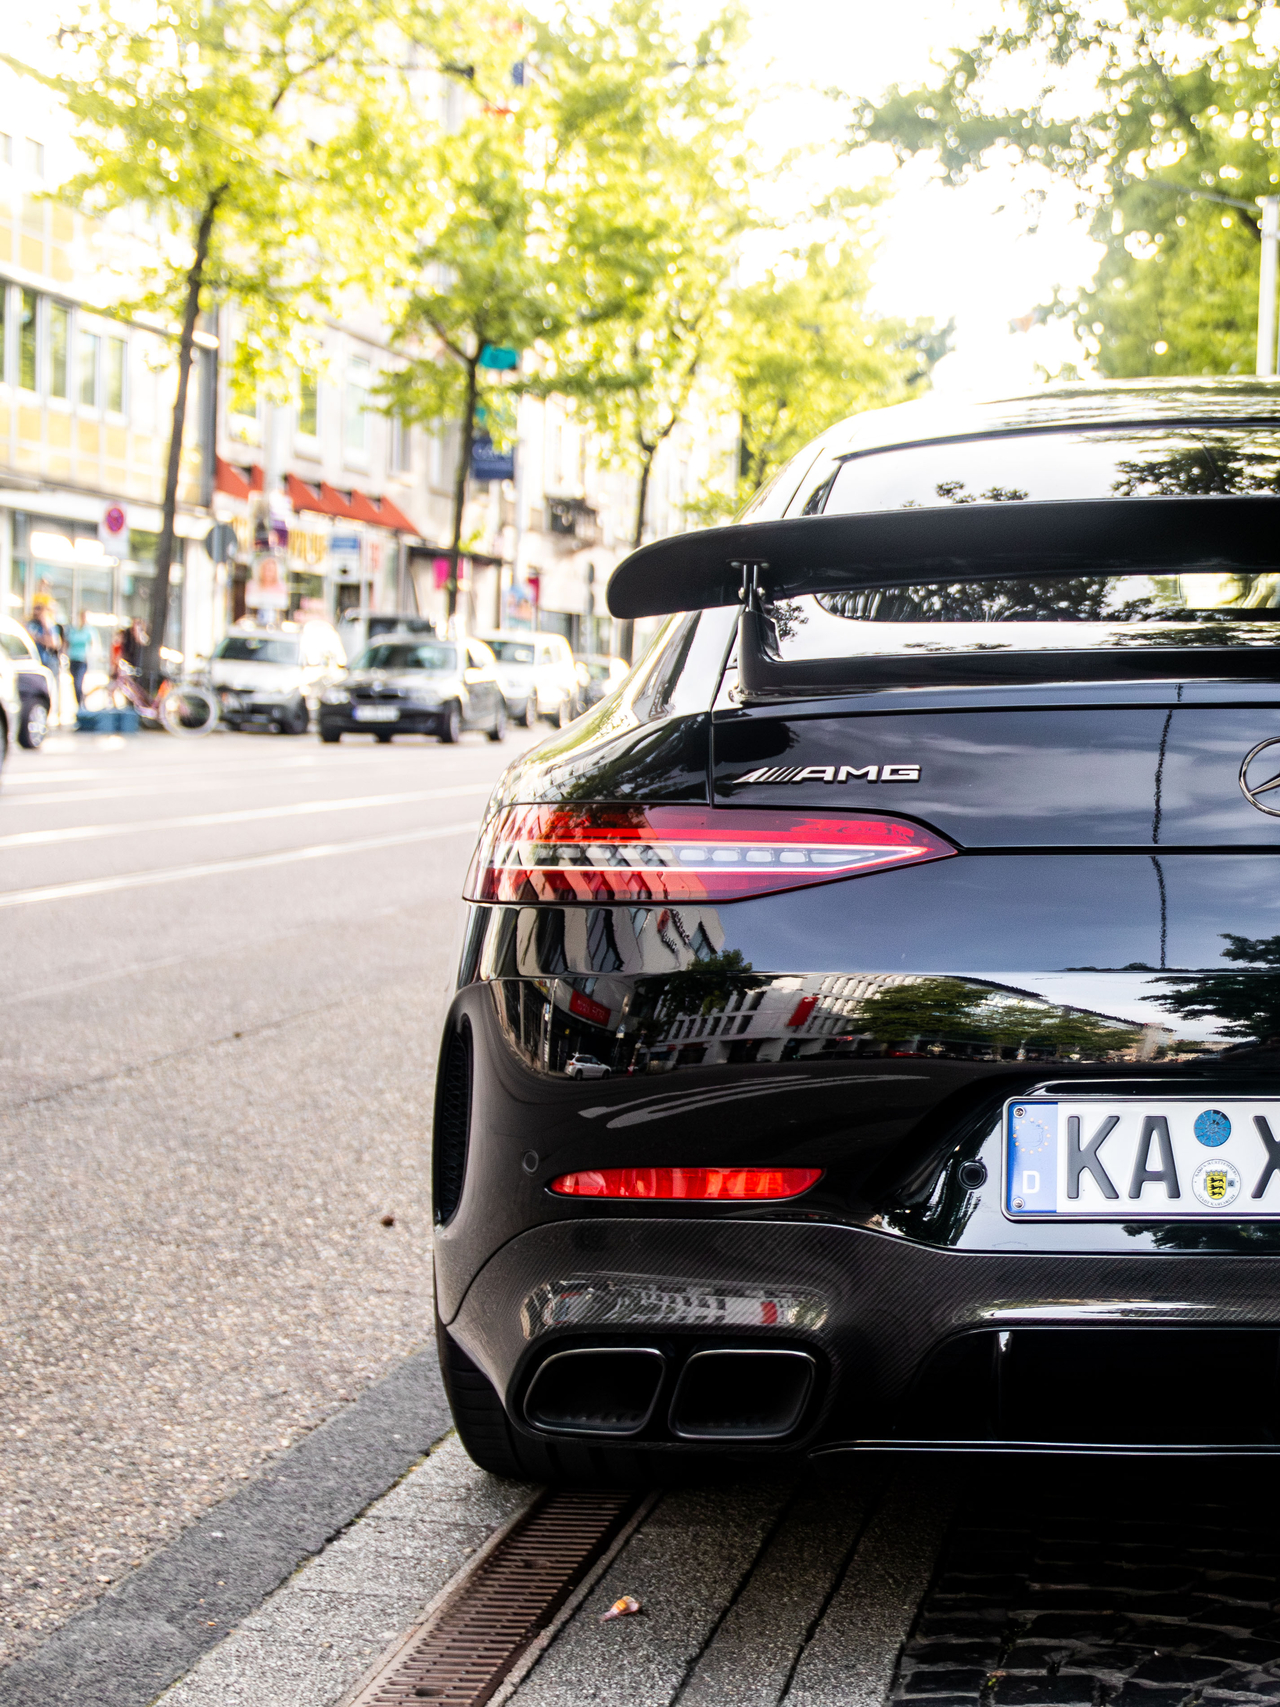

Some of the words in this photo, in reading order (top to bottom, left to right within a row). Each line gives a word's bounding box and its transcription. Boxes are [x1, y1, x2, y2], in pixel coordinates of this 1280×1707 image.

[790, 765, 921, 783] AMG
[1066, 1115, 1181, 1200] KA
[1022, 1170, 1040, 1194] D
